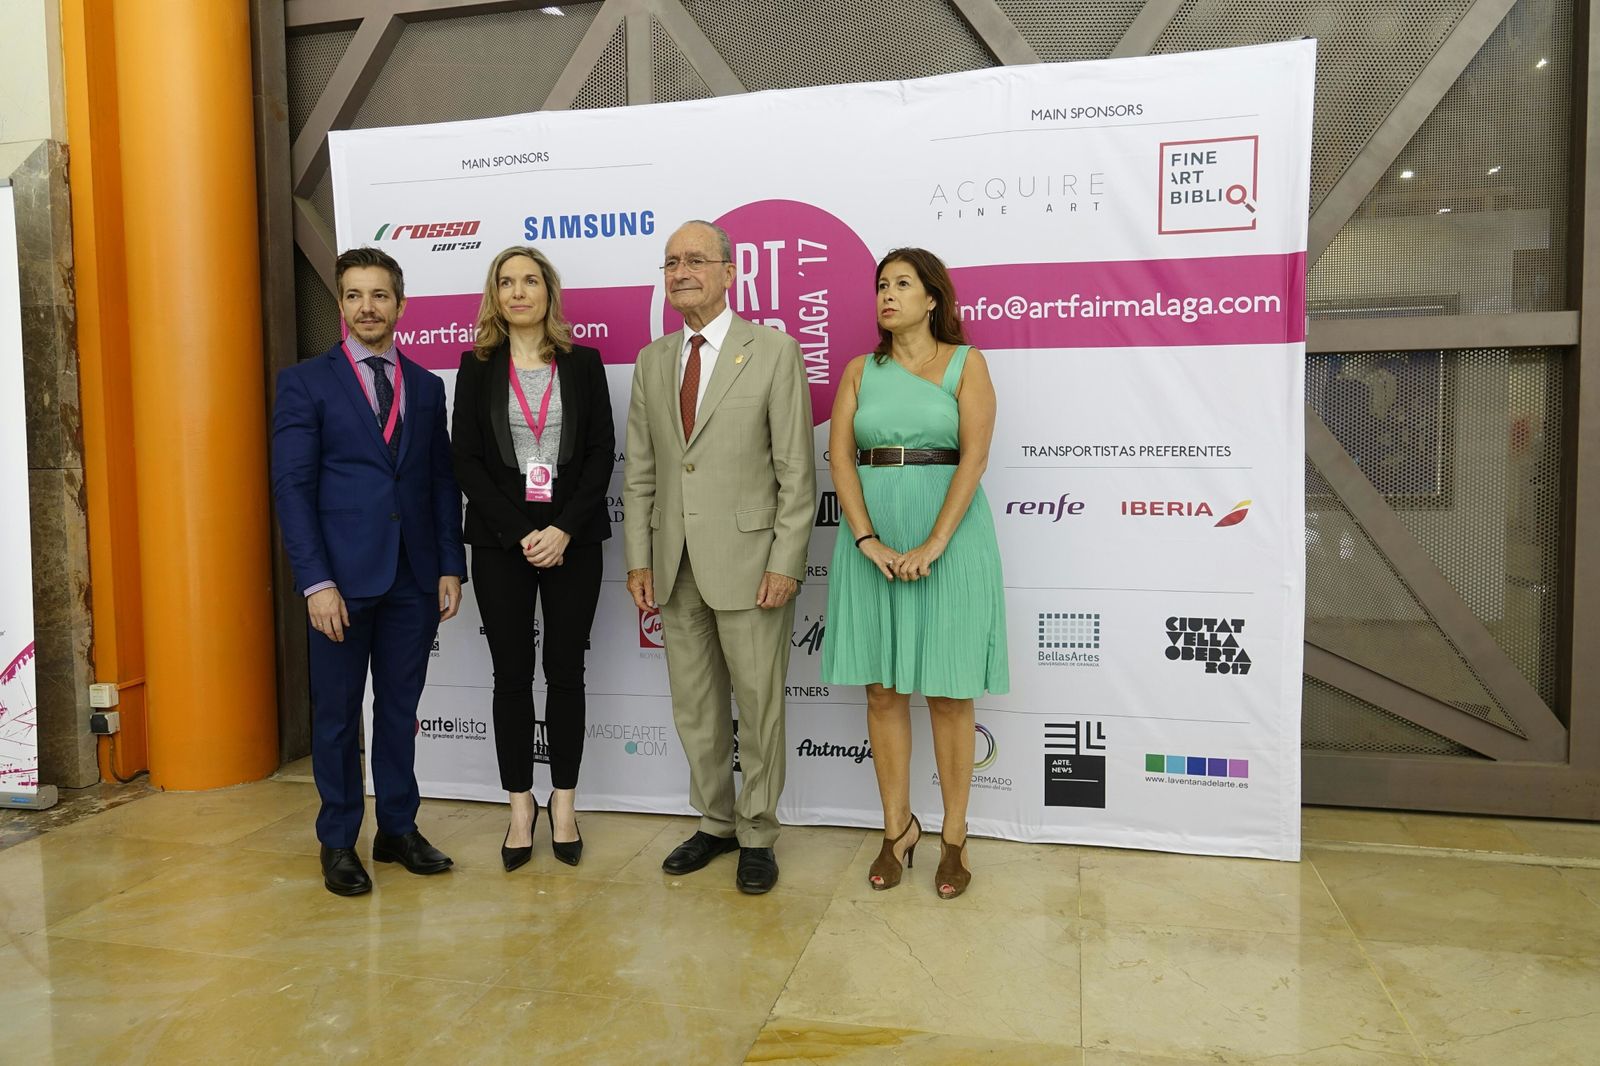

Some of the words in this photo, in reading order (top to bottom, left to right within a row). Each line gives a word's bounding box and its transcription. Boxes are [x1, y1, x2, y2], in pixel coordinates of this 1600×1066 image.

[1031, 106, 1067, 121] MAIN
[1070, 103, 1143, 119] SPONSORS
[462, 157, 490, 170] MAIN
[492, 151, 550, 167] SPONSORS
[1171, 150, 1217, 167] FINE
[929, 173, 1105, 206] ACQUIRE
[936, 206, 1008, 220] FINE
[1045, 201, 1101, 213] ART
[523, 210, 654, 241] SAMSUNG
[726, 240, 786, 312] RT
[954, 291, 1281, 323] info@artfairmalaga.com
[1021, 445, 1136, 457] TRANSPORTISTAS
[1139, 445, 1232, 457] PREFERENTES
[1006, 493, 1085, 522] renfe
[1121, 501, 1213, 517] IBERIA
[1165, 616, 1245, 633] CIUTAT
[1165, 631, 1240, 648] VELLA
[1038, 651, 1100, 662] BellasArtes
[1164, 645, 1252, 663] OBERTA
[784, 686, 829, 697] RTNERS
[420, 716, 486, 734] artelista
[585, 723, 667, 741] MASDEARTE
[1145, 775, 1249, 789] www.laventanadelarte.es
